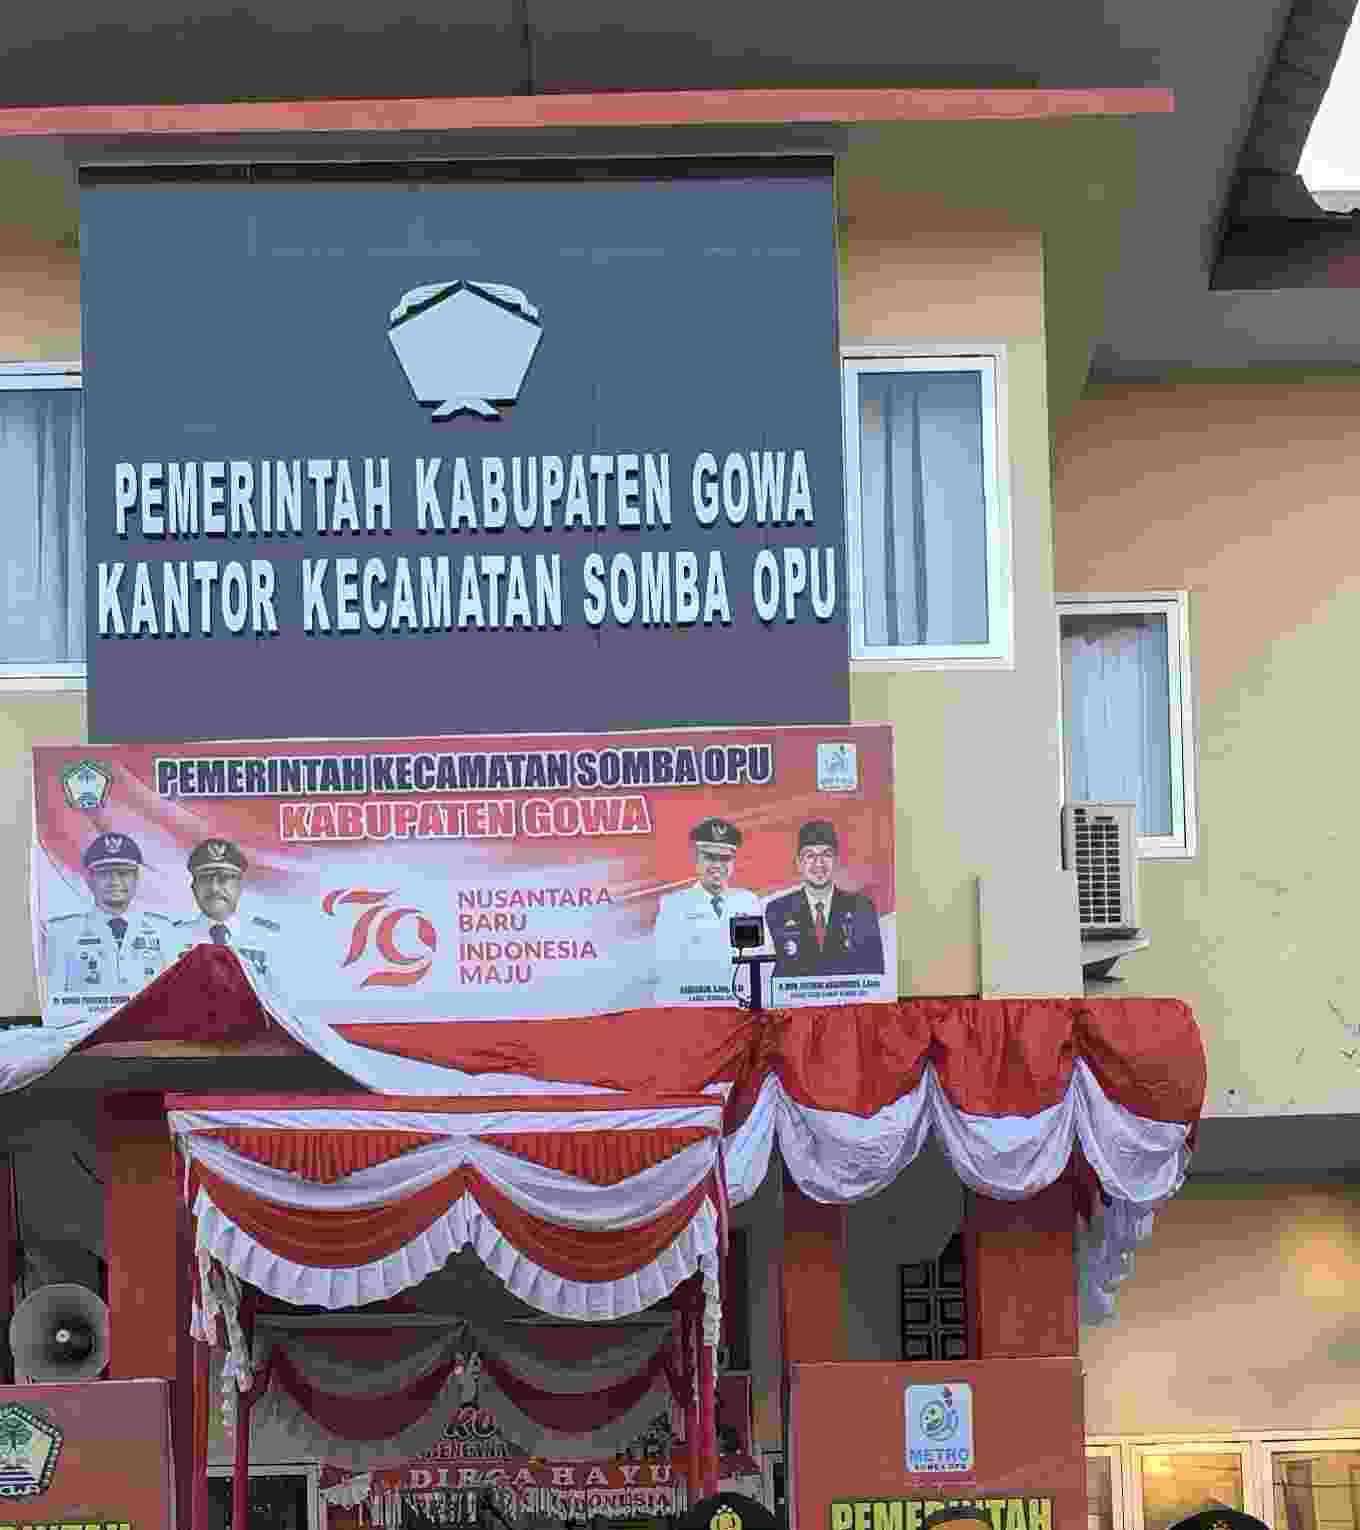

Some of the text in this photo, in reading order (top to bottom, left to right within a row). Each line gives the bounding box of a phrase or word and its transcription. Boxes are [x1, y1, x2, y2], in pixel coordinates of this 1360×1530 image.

[115, 450, 815, 535] PEMERINTAH KABUPATEN GOWA
[97, 547, 837, 637] KANTOR KECAMATAN SOMBA OPU
[155, 744, 772, 796] PEMERINTAH KECAMATAN SOMBA OPU
[280, 796, 653, 841] KABUPATEN GOWA
[456, 888, 613, 909] NUSANTARA
[458, 912, 528, 933] BARU
[458, 940, 598, 962] INDONESIA
[459, 964, 532, 985] MAJU
